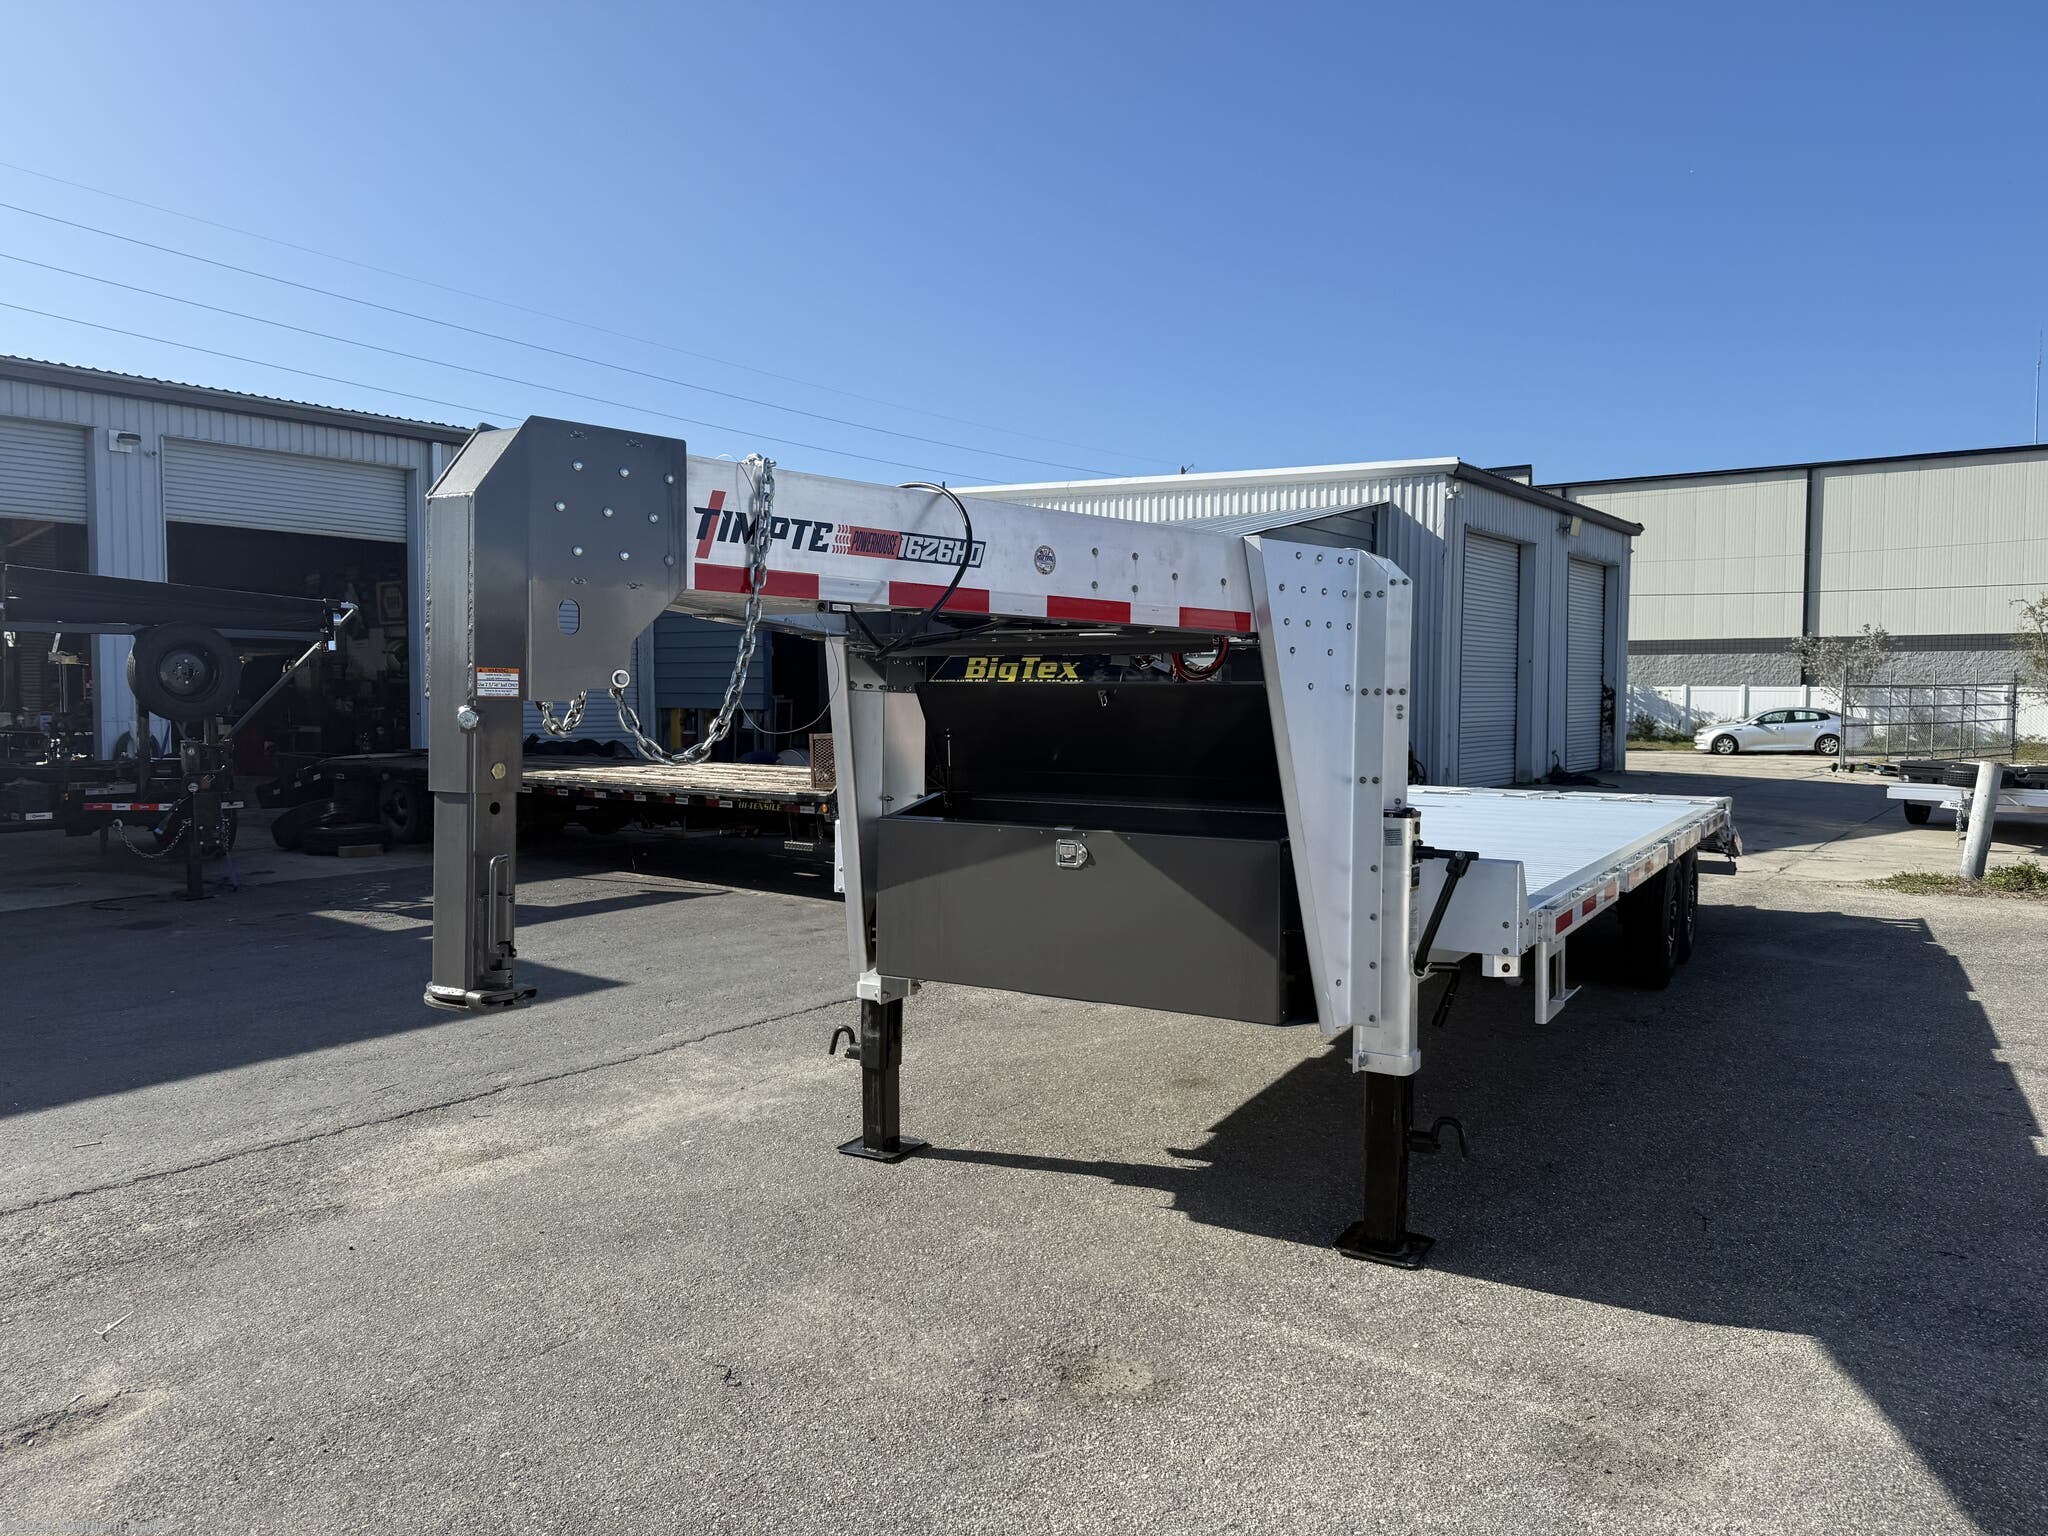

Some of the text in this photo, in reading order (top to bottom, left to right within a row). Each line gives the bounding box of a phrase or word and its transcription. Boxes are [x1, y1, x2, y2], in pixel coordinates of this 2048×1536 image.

[693, 490, 984, 566] TIMPTE POWERHOUSE 1626HD
[964, 656, 1081, 683] BigTex
